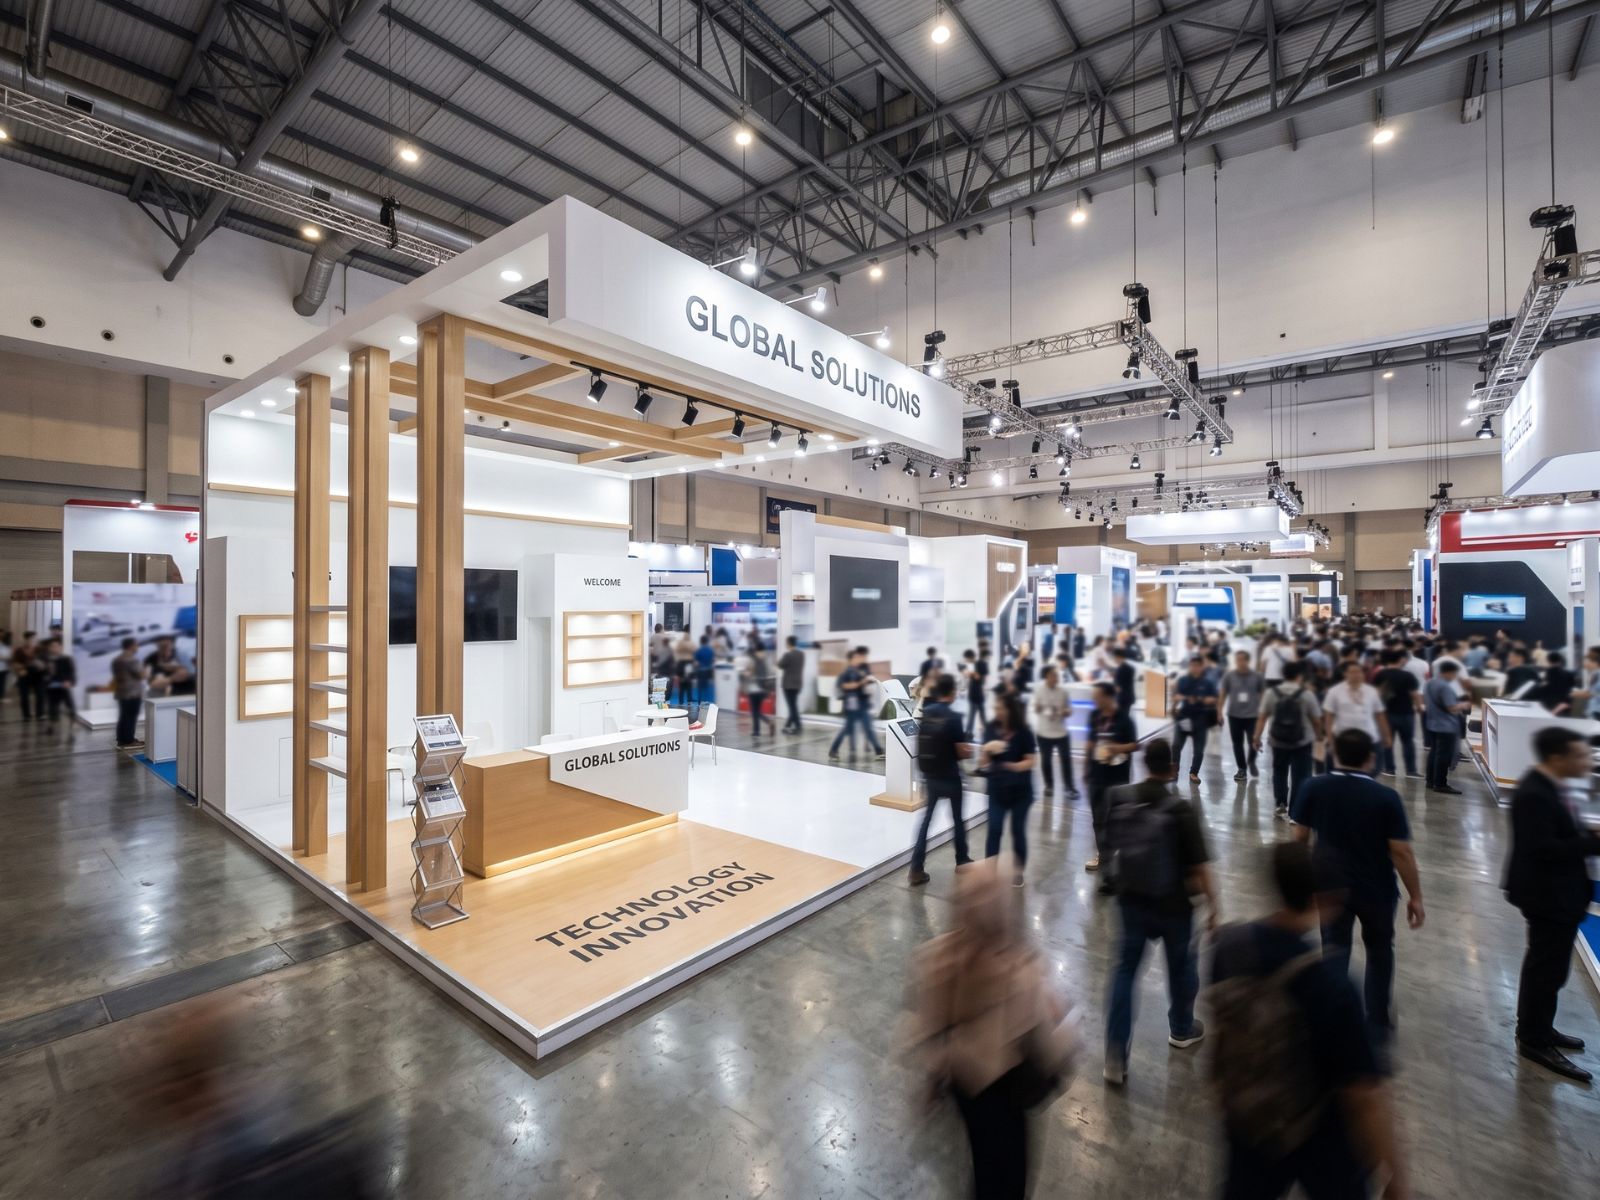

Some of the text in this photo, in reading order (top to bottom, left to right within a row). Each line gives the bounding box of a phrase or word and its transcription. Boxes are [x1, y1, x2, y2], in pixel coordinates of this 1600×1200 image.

[685, 295, 921, 418] GLOBAL SOLUTIONS
[583, 578, 621, 586] WELCOME
[564, 739, 681, 772] GLOBAL SOLUTIONS
[535, 861, 747, 947] TECHNOLOGY
[568, 872, 775, 963] INNOVATION
